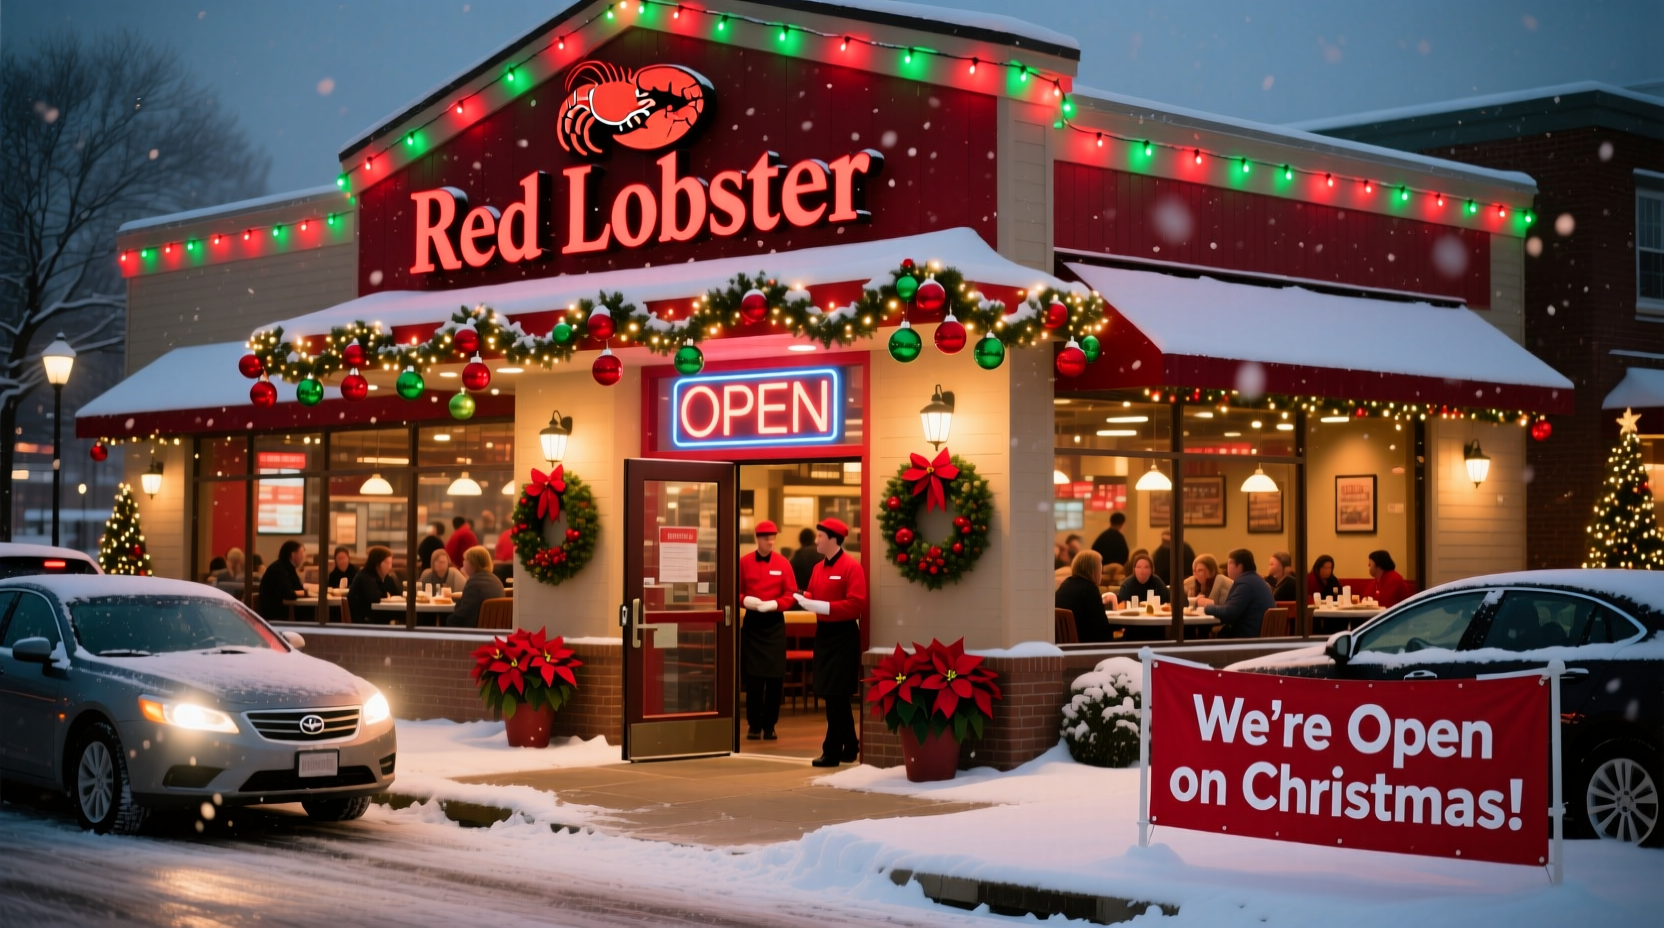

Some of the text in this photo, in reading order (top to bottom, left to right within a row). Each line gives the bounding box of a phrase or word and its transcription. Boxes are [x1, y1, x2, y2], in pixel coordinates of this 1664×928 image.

[410, 150, 871, 274] Red Lobster
[681, 380, 828, 438] OPEN
[1193, 693, 1493, 769] We’re Open
[1169, 761, 1524, 831] on Christmas!
